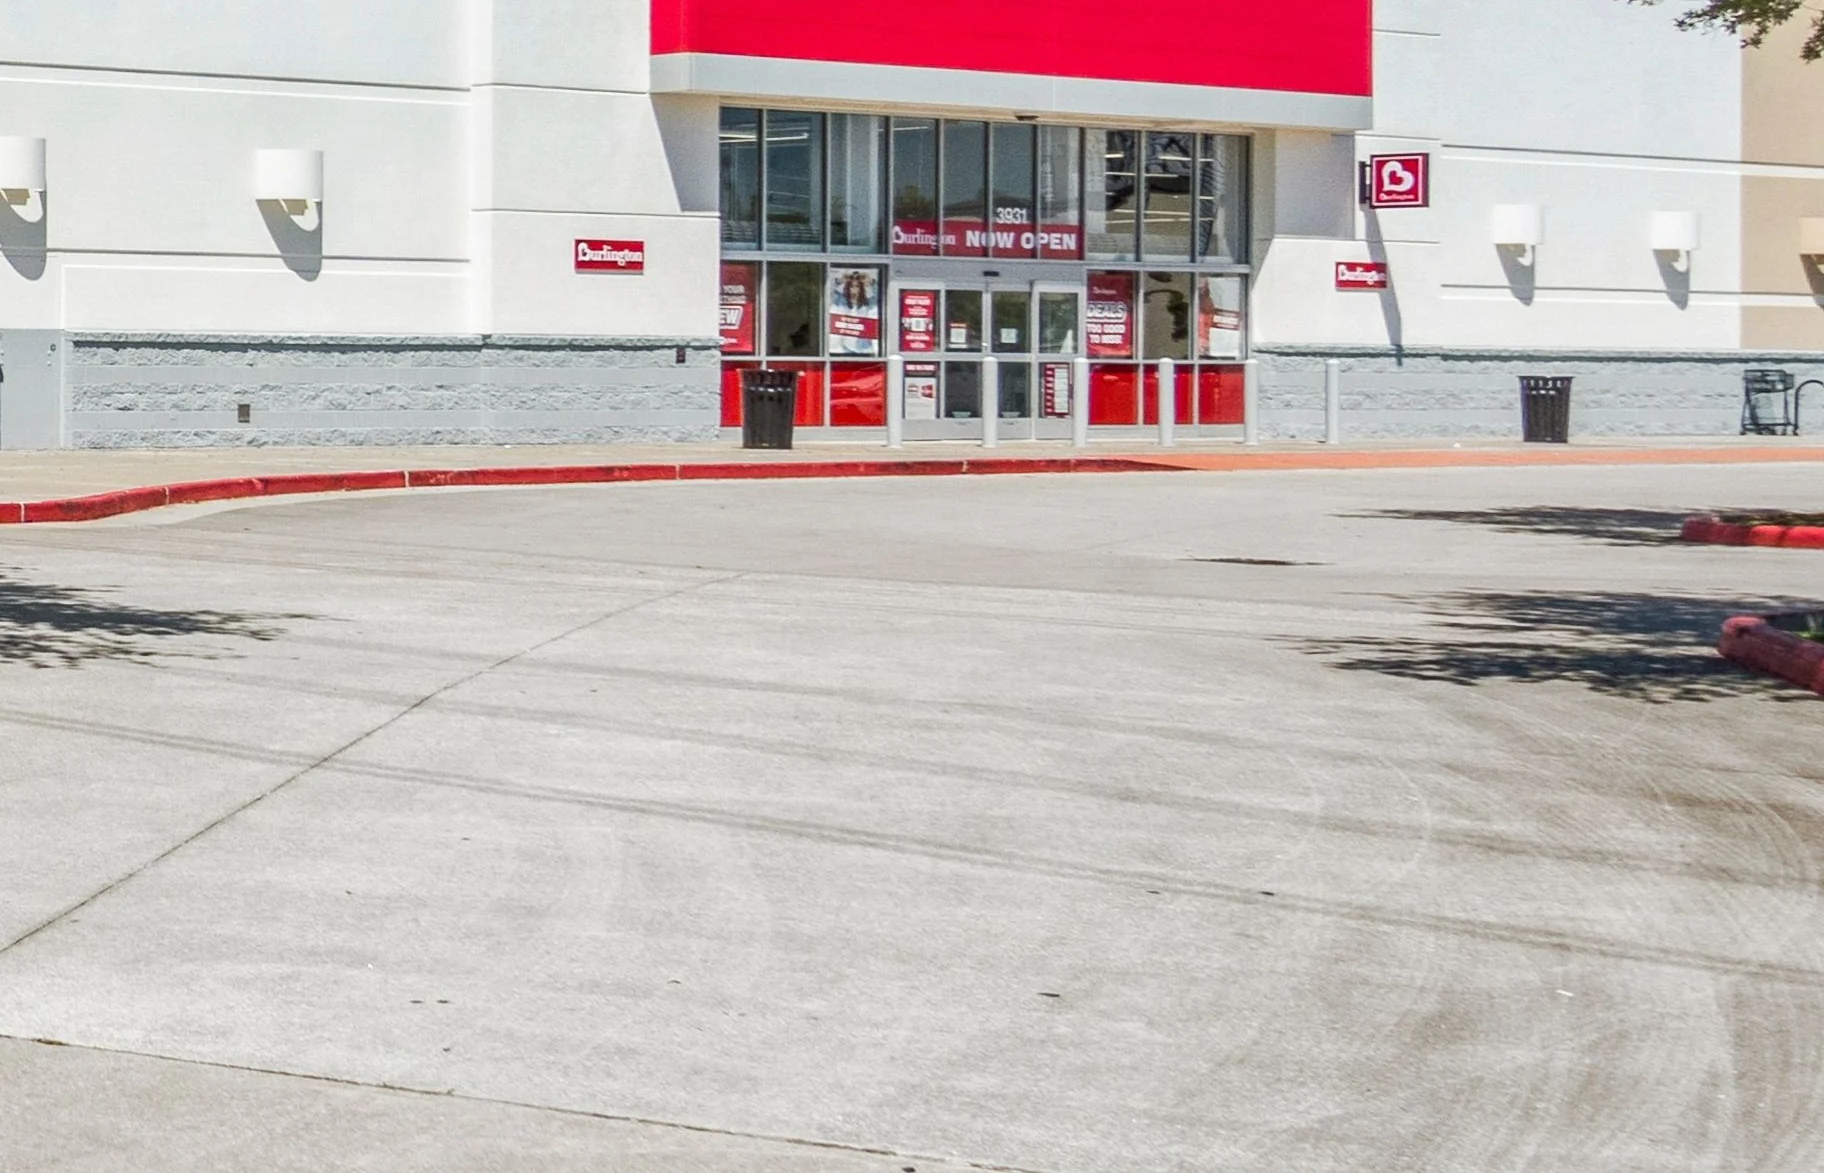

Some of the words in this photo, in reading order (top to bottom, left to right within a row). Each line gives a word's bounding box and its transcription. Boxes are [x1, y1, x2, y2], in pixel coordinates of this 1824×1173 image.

[995, 207, 1028, 225] 3931
[892, 224, 956, 249] Burlingon
[965, 229, 1016, 249] NOW
[1020, 231, 1077, 250] OPEN
